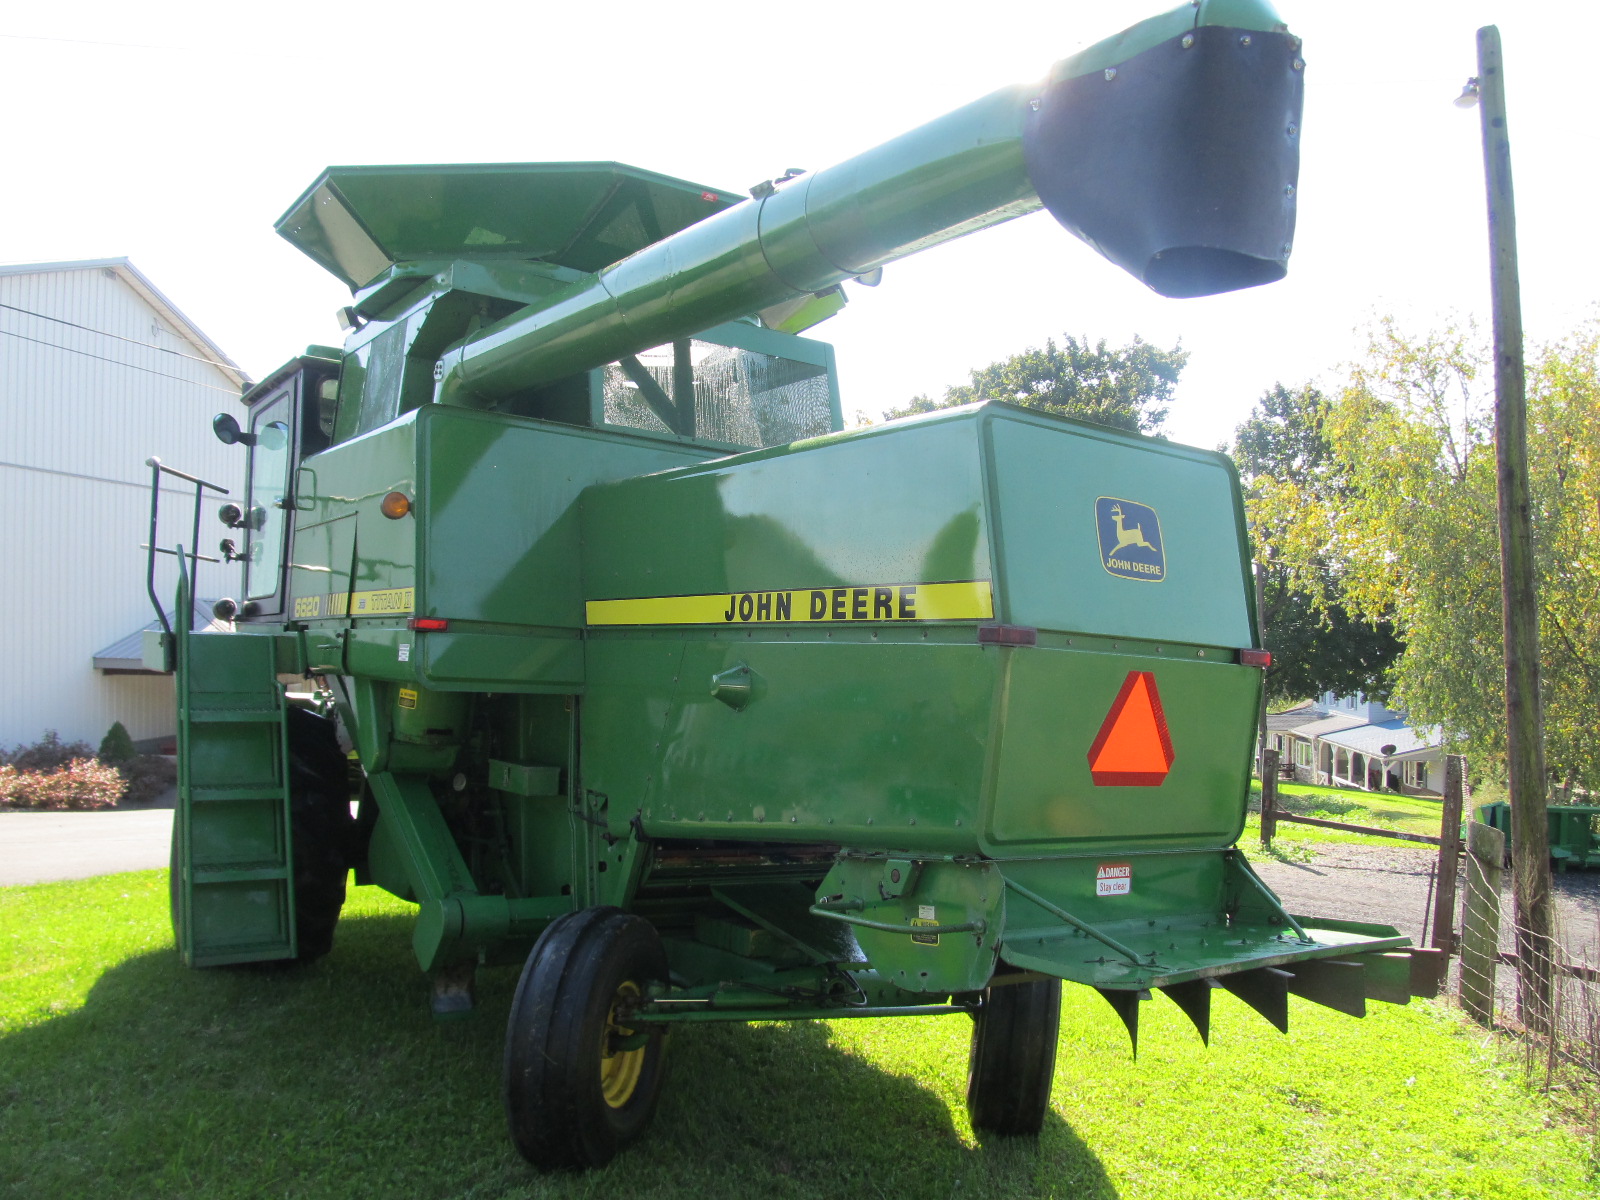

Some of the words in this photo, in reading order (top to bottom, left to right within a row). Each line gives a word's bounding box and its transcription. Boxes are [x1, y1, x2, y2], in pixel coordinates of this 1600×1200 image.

[1107, 558, 1131, 570] JOHN
[1132, 562, 1162, 575] DEERE
[294, 597, 320, 617] 6620
[371, 592, 402, 610] TITAN
[725, 592, 791, 621] JOHN
[810, 587, 917, 620] DEERE
[1106, 867, 1130, 878] DANGER
[1100, 882, 1111, 893] Stay
[1113, 882, 1126, 890] clear
